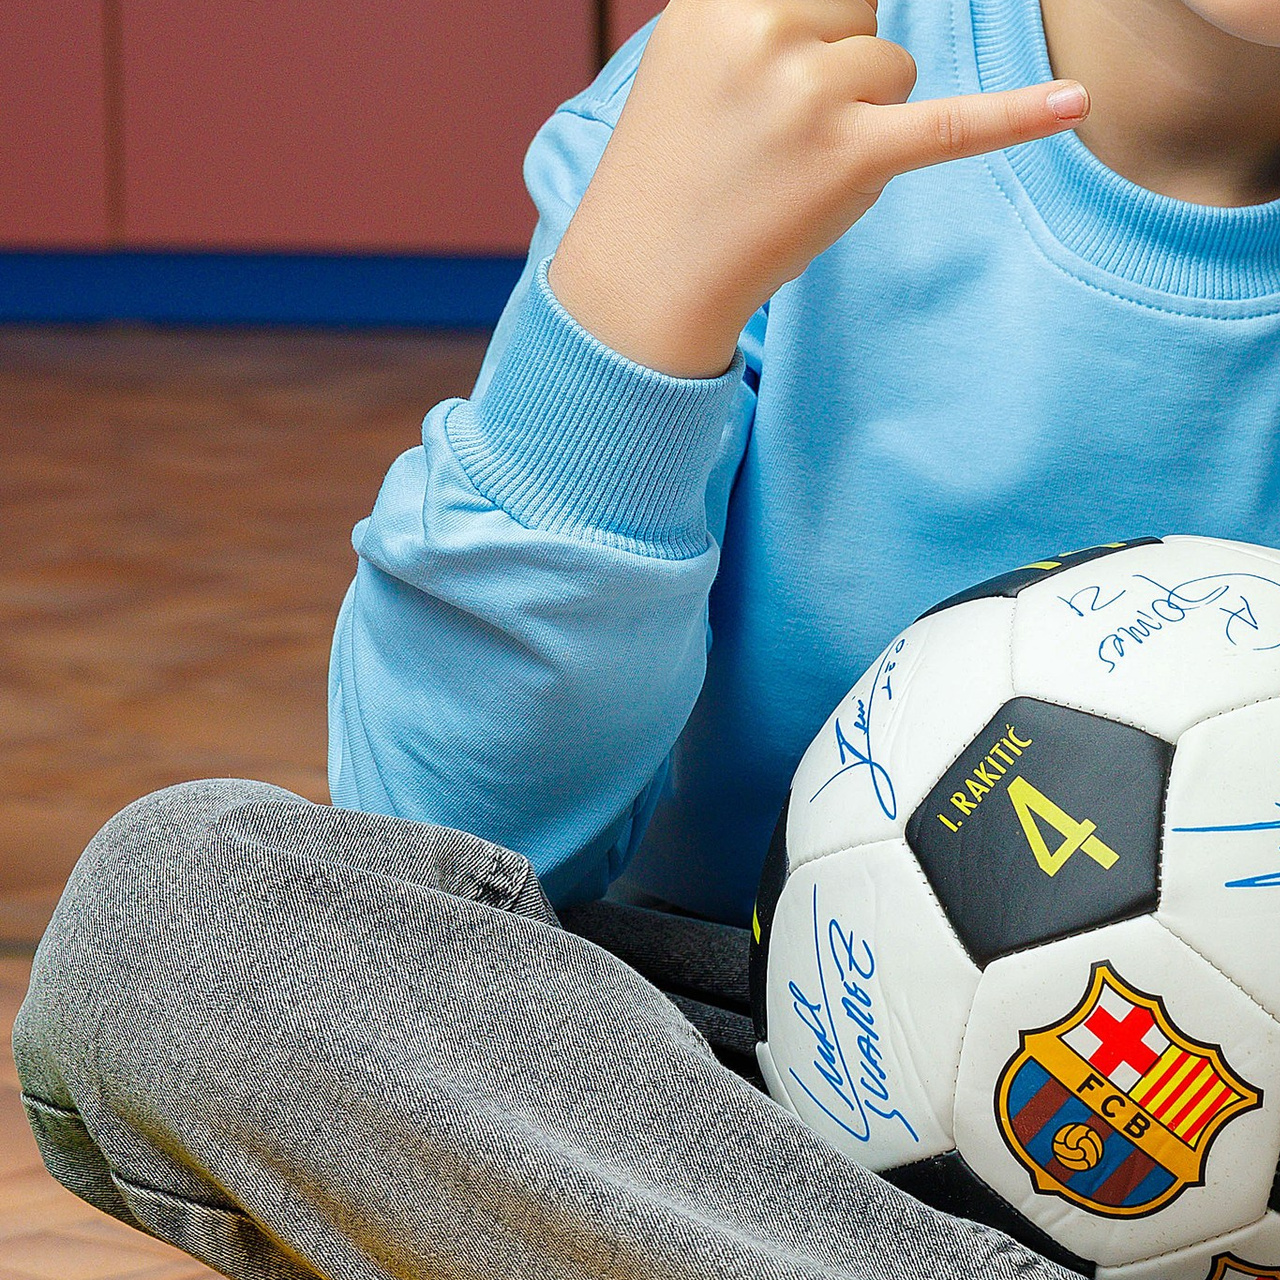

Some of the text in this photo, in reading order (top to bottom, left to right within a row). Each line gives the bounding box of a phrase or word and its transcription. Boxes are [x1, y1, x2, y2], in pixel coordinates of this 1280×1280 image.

[936, 723, 1033, 833] I. RAKITIĆ
[1006, 775, 1120, 878] 4
[1075, 1072, 1152, 1139] FCB
